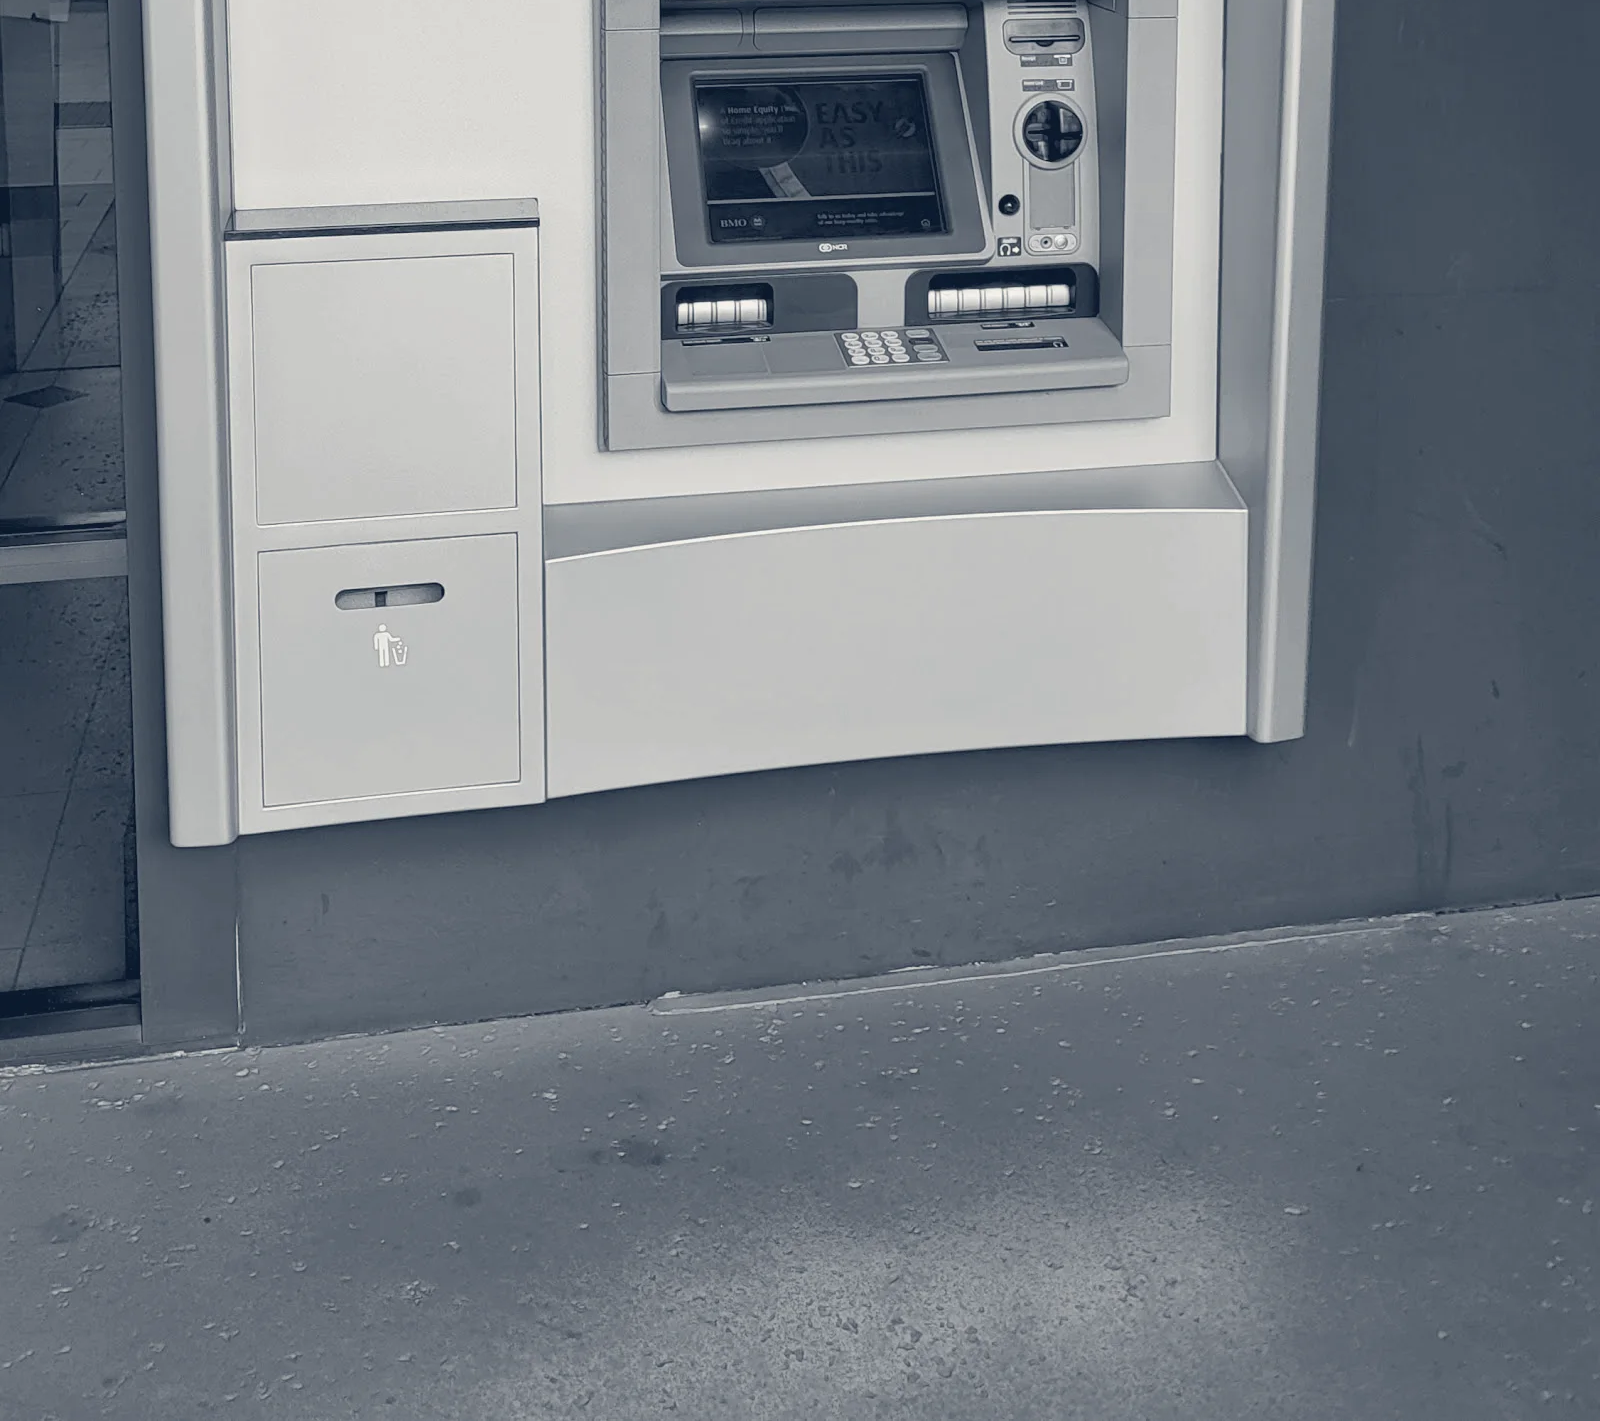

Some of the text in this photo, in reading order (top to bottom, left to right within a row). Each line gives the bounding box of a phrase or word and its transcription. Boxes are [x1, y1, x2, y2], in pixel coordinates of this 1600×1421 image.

[727, 106, 752, 115] Home
[753, 105, 779, 116] Equity
[816, 100, 884, 125] EASY
[819, 126, 856, 149] AS
[720, 218, 748, 228] BMO
